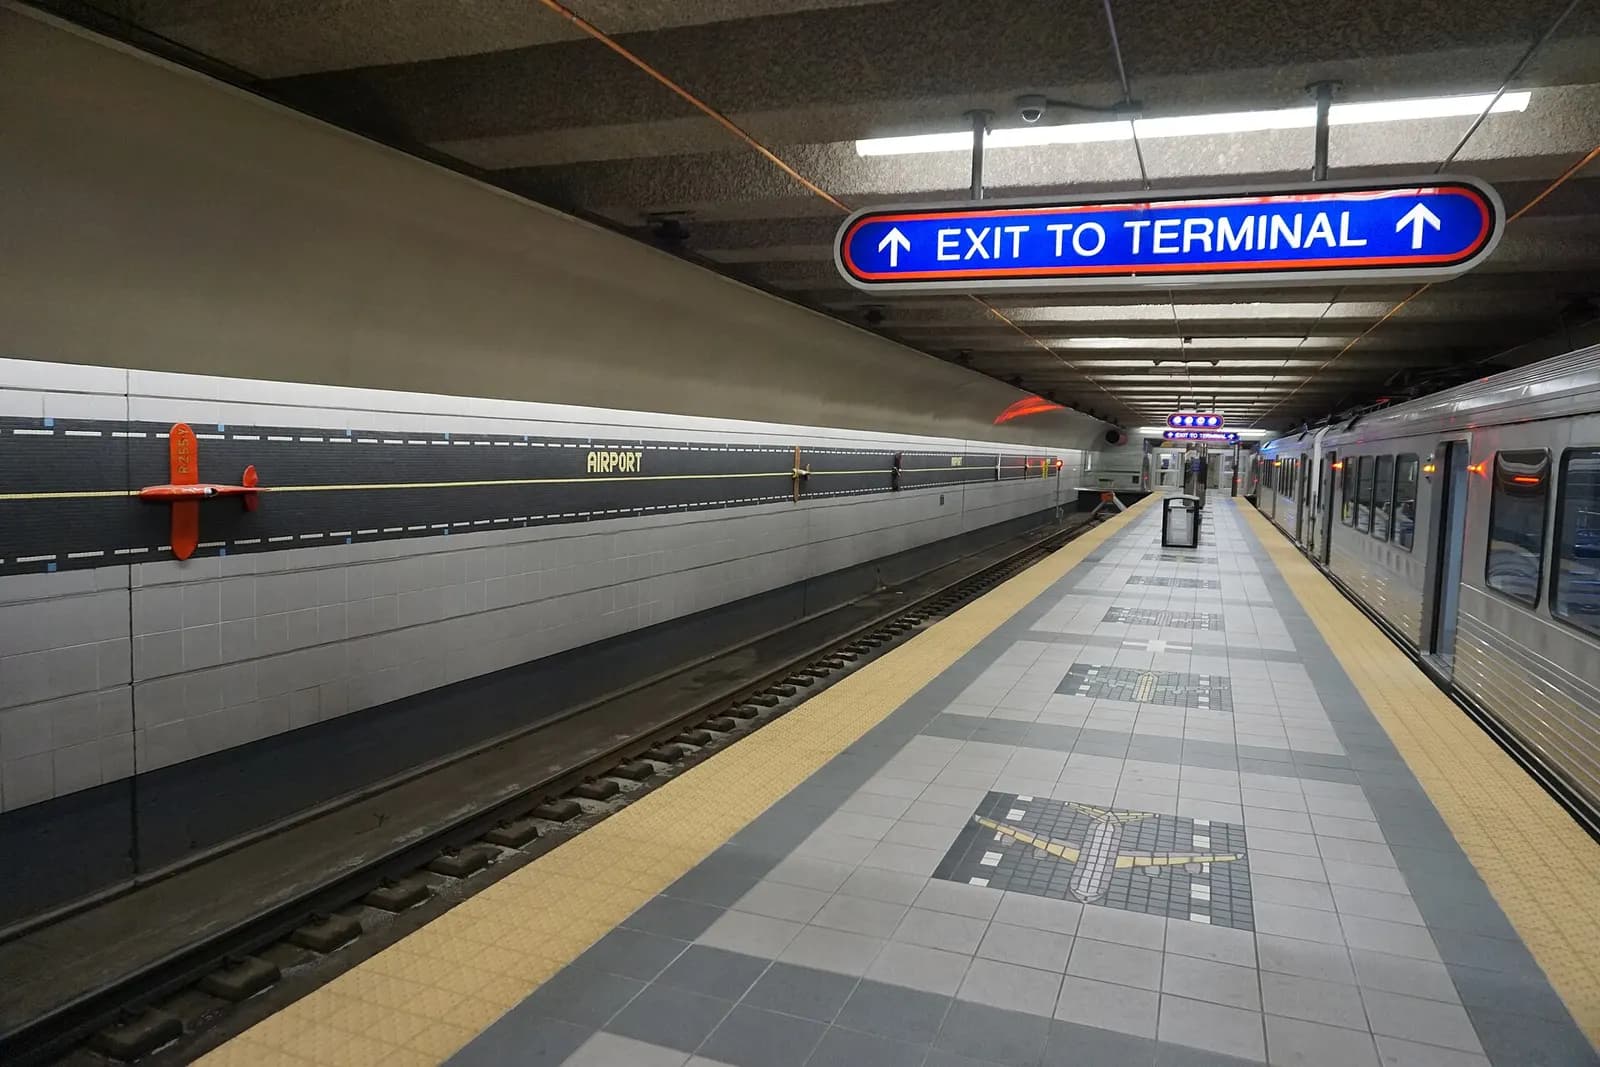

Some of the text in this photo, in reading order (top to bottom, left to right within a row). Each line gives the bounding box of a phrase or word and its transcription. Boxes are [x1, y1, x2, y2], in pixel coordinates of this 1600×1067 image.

[937, 211, 1368, 263] EXIT TO TERMINAL
[587, 451, 643, 473] AIRPORT
